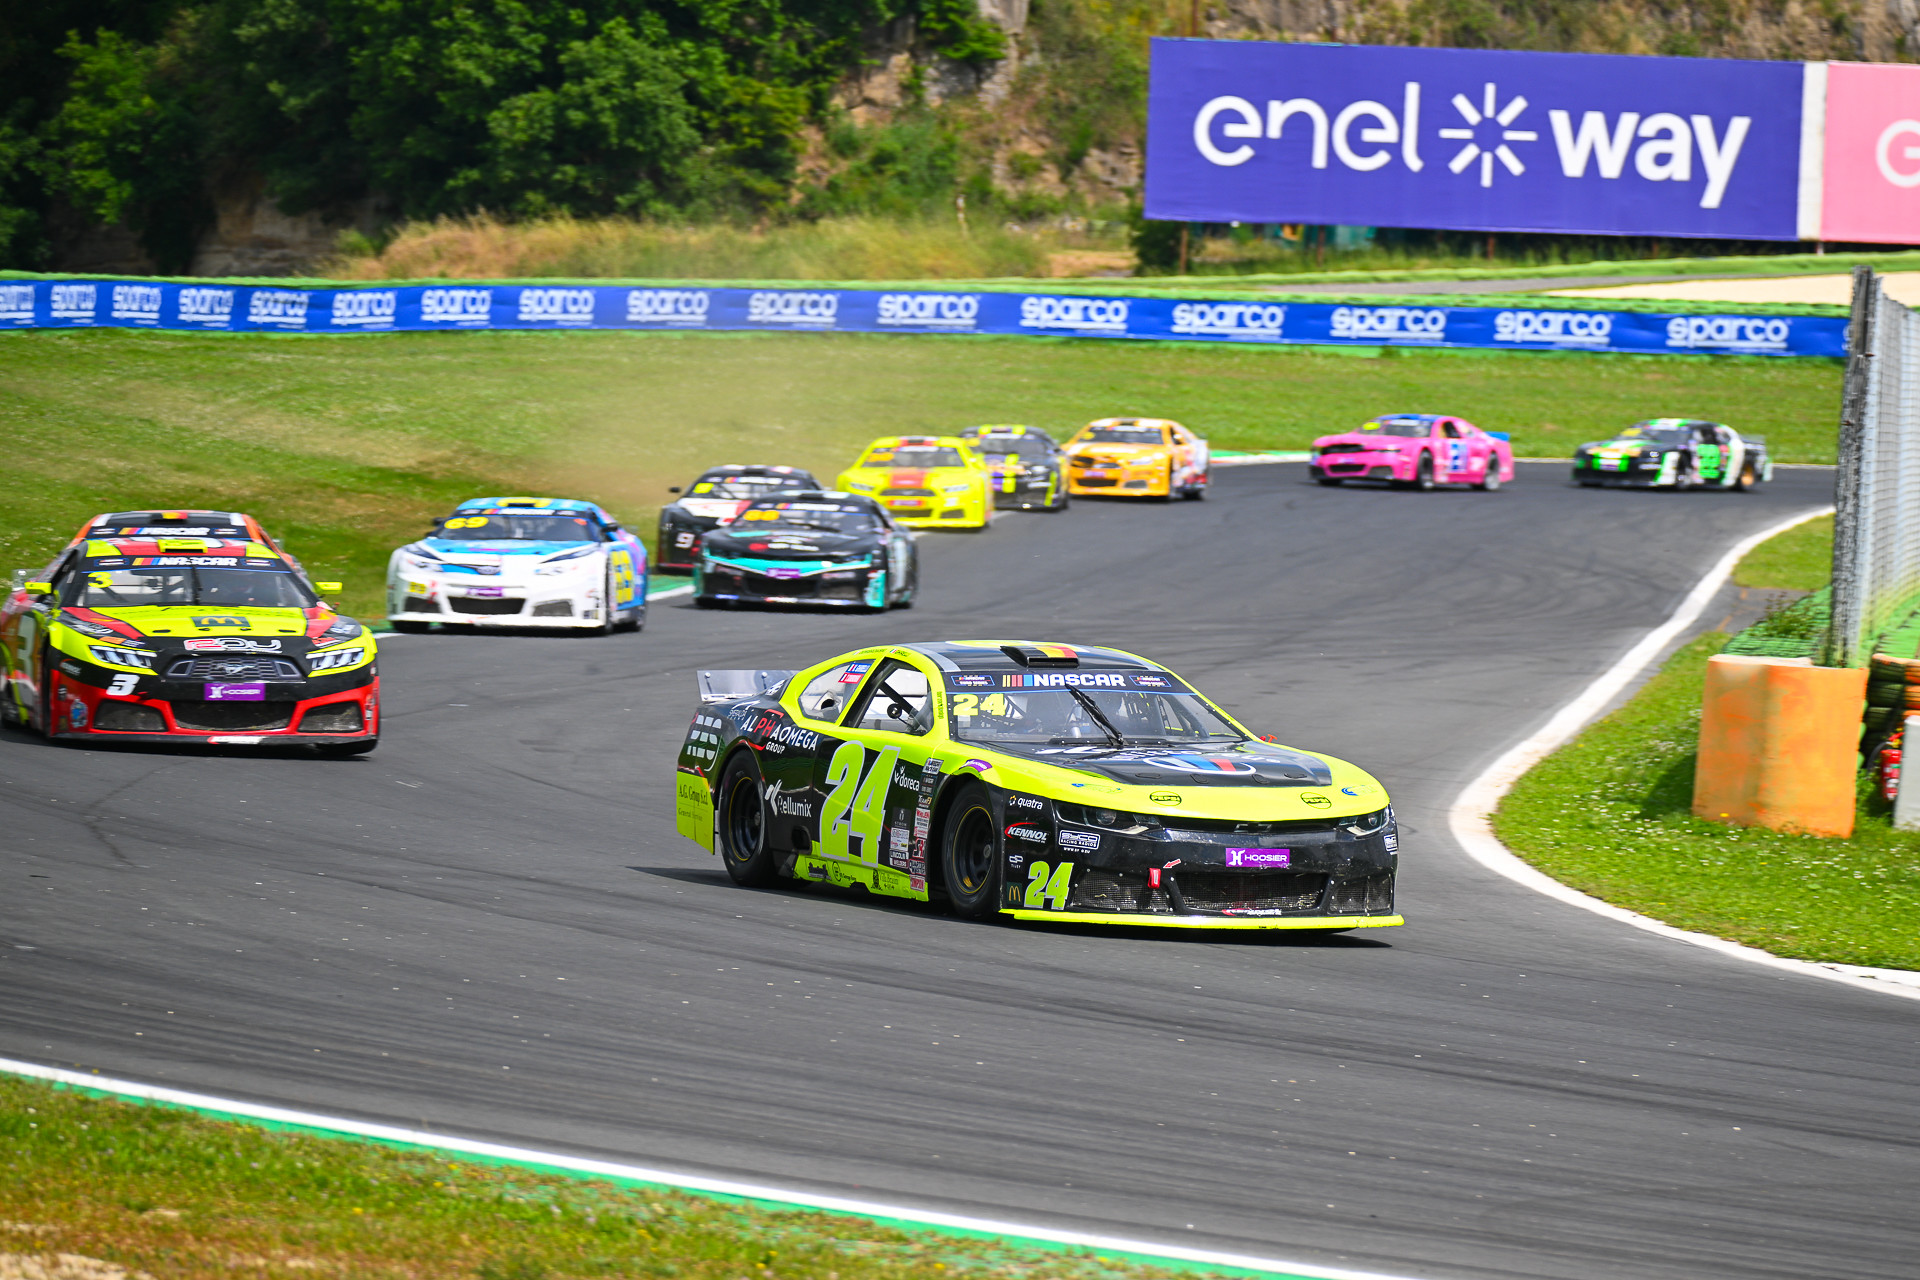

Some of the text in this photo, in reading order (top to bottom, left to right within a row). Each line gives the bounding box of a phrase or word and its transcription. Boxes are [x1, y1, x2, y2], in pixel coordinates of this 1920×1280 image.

[1194, 82, 1752, 209] enel way
[331, 292, 396, 325] sparco
[421, 289, 492, 321] sparco
[517, 288, 595, 320] sparco
[626, 289, 710, 324] sparco
[747, 291, 838, 322] sparco
[877, 293, 979, 325] sparco
[1020, 296, 1128, 330] sparco
[1171, 303, 1285, 336] sparco
[1329, 305, 1446, 339] sparco
[1494, 309, 1611, 344] sparco
[1665, 316, 1789, 349] sparco
[142, 527, 210, 536] NASCAR
[444, 517, 489, 529] 69
[157, 557, 237, 567] NASCAR
[88, 571, 114, 588] 3
[106, 674, 140, 696] 3
[1033, 673, 1126, 687] NASCAR
[953, 693, 1006, 716] 24
[740, 714, 820, 751] ALPHAOMEGA
[765, 741, 786, 754] GROUP
[819, 740, 901, 868] 24
[1017, 797, 1043, 810] quatra
[1007, 826, 1048, 841] KENNOL
[1244, 854, 1288, 862] HOOSIER
[1023, 860, 1074, 910] 24
